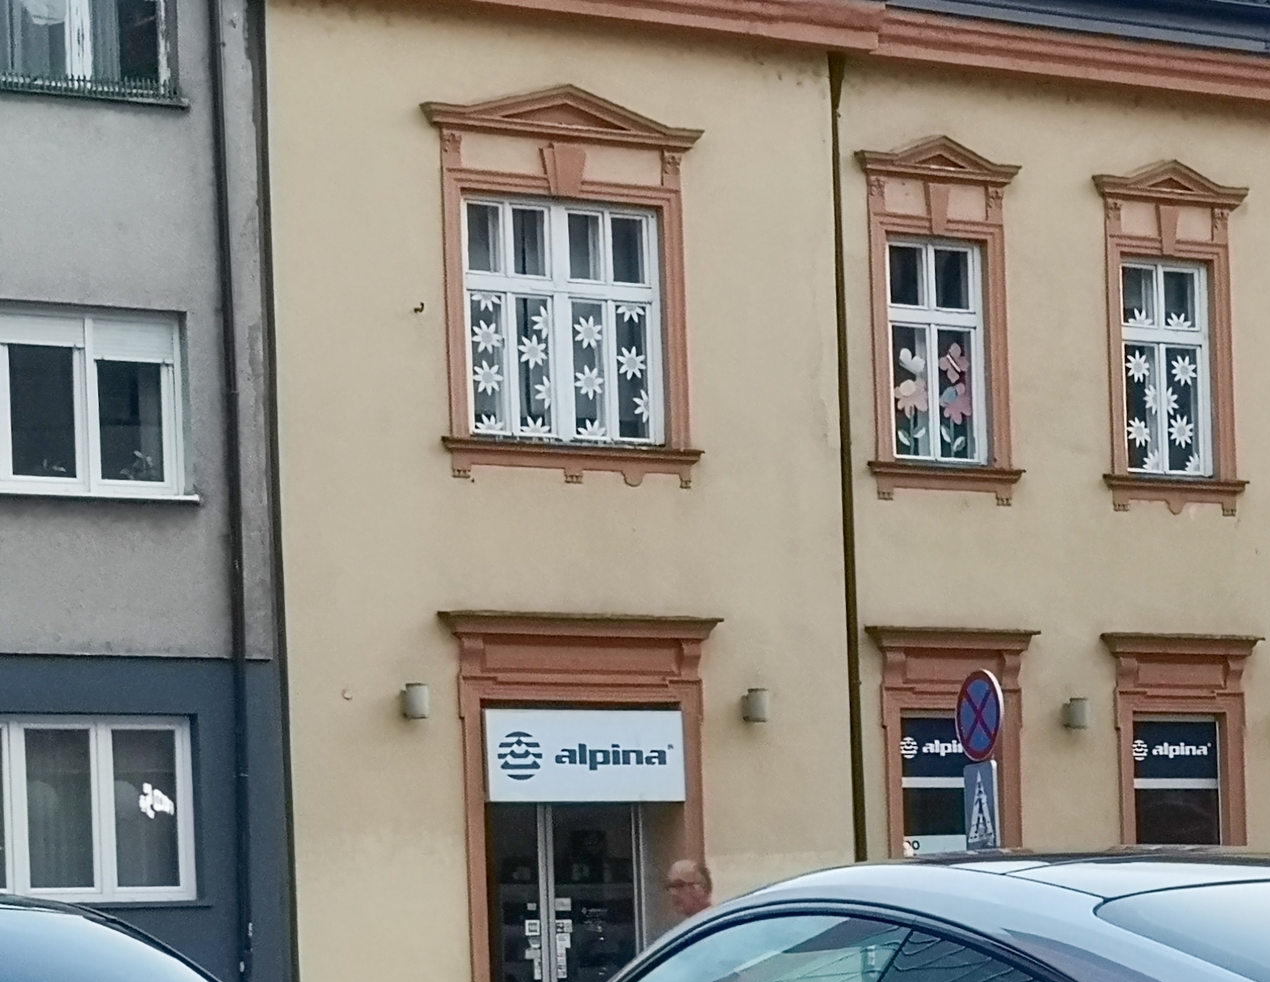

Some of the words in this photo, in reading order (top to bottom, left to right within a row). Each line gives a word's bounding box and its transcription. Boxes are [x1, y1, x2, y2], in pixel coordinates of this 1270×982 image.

[555, 743, 669, 771] alpina
[922, 739, 964, 757] alpi
[1151, 742, 1208, 759] alpina
